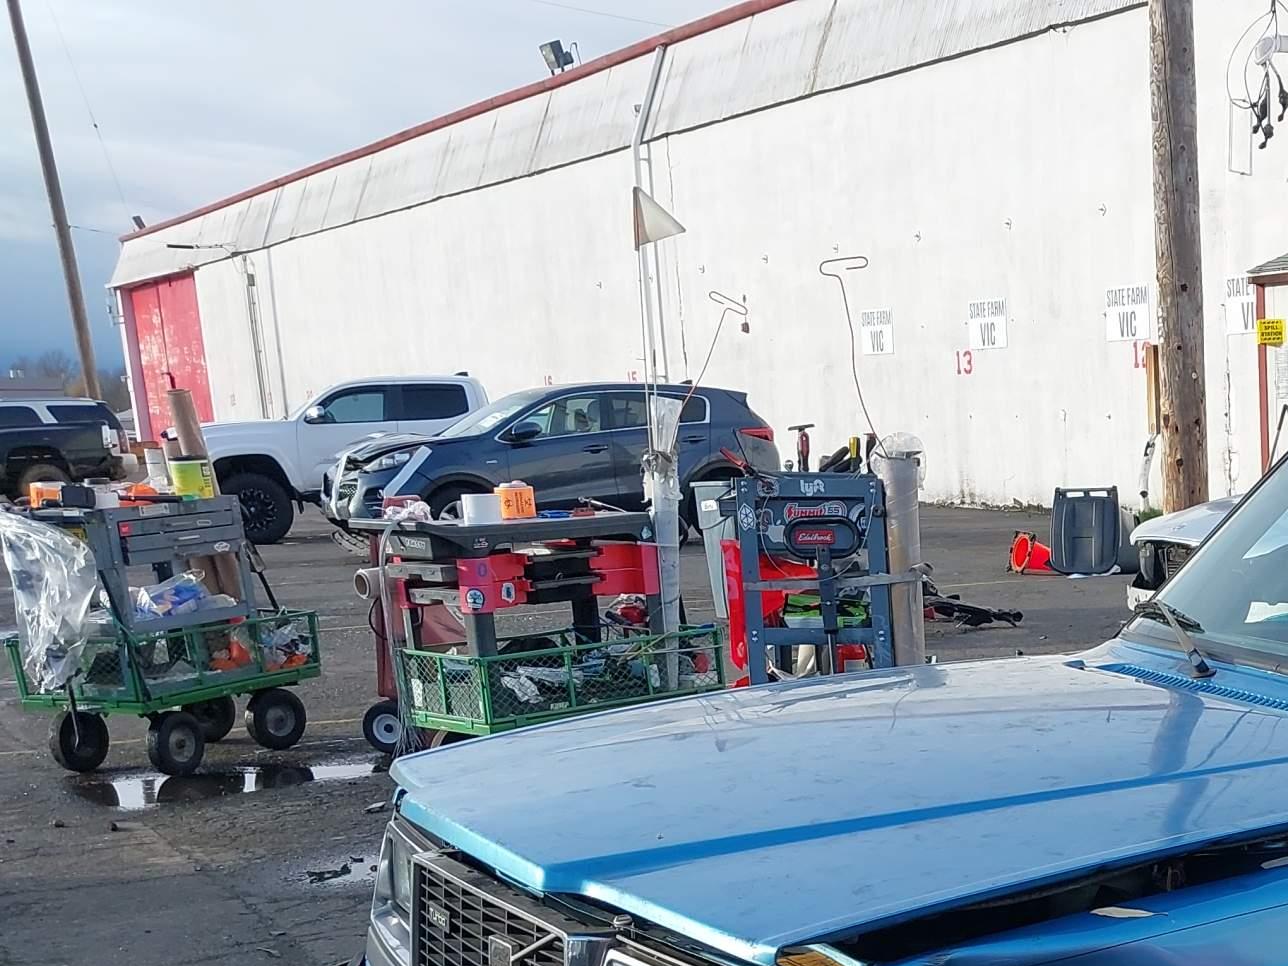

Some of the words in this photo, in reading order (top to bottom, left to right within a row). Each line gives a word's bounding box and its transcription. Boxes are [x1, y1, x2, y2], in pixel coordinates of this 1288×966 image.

[1106, 288, 1126, 308] STATE
[1127, 286, 1148, 306] FARM
[1227, 276, 1250, 298] STATE
[861, 311, 876, 327] STATE
[876, 310, 892, 326] FARM
[969, 302, 987, 320] STATE
[987, 300, 1005, 318] FARM
[1241, 301, 1255, 330] VI
[980, 322, 996, 347] VIC
[1118, 311, 1137, 338] VIC
[870, 330, 884, 353] VIC
[956, 350, 973, 375] 13
